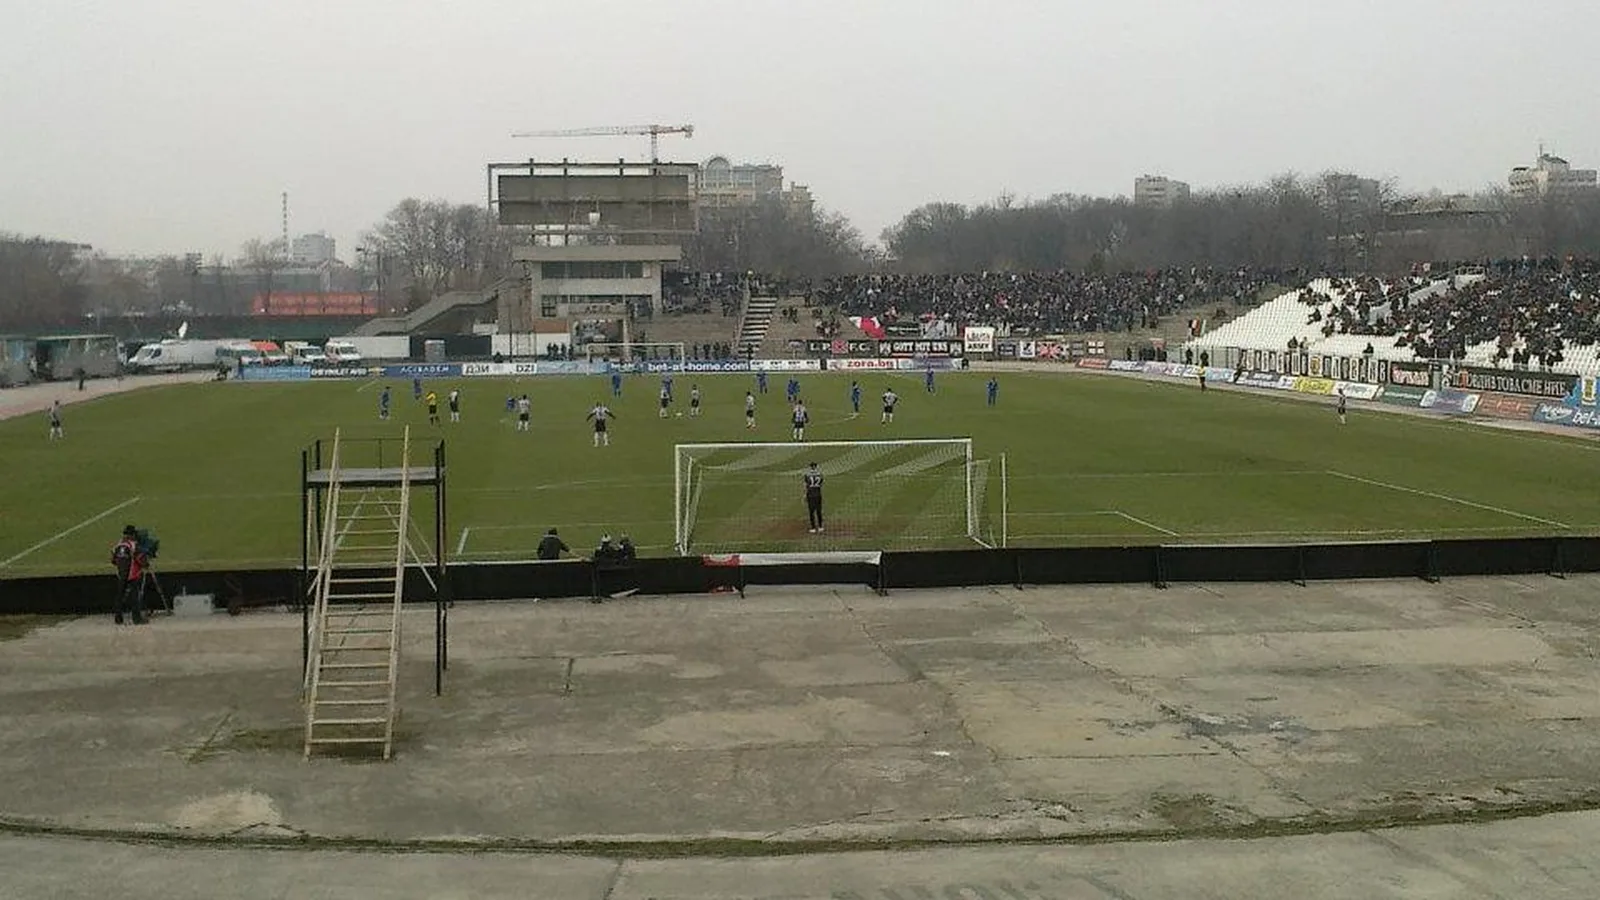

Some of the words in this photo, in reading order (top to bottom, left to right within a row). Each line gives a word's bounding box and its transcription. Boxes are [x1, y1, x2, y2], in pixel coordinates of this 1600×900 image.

[515, 364, 535, 373] DZI
[648, 363, 749, 371] bet-at-home.com
[847, 361, 893, 370] zora.bg
[809, 476, 821, 488] 12
